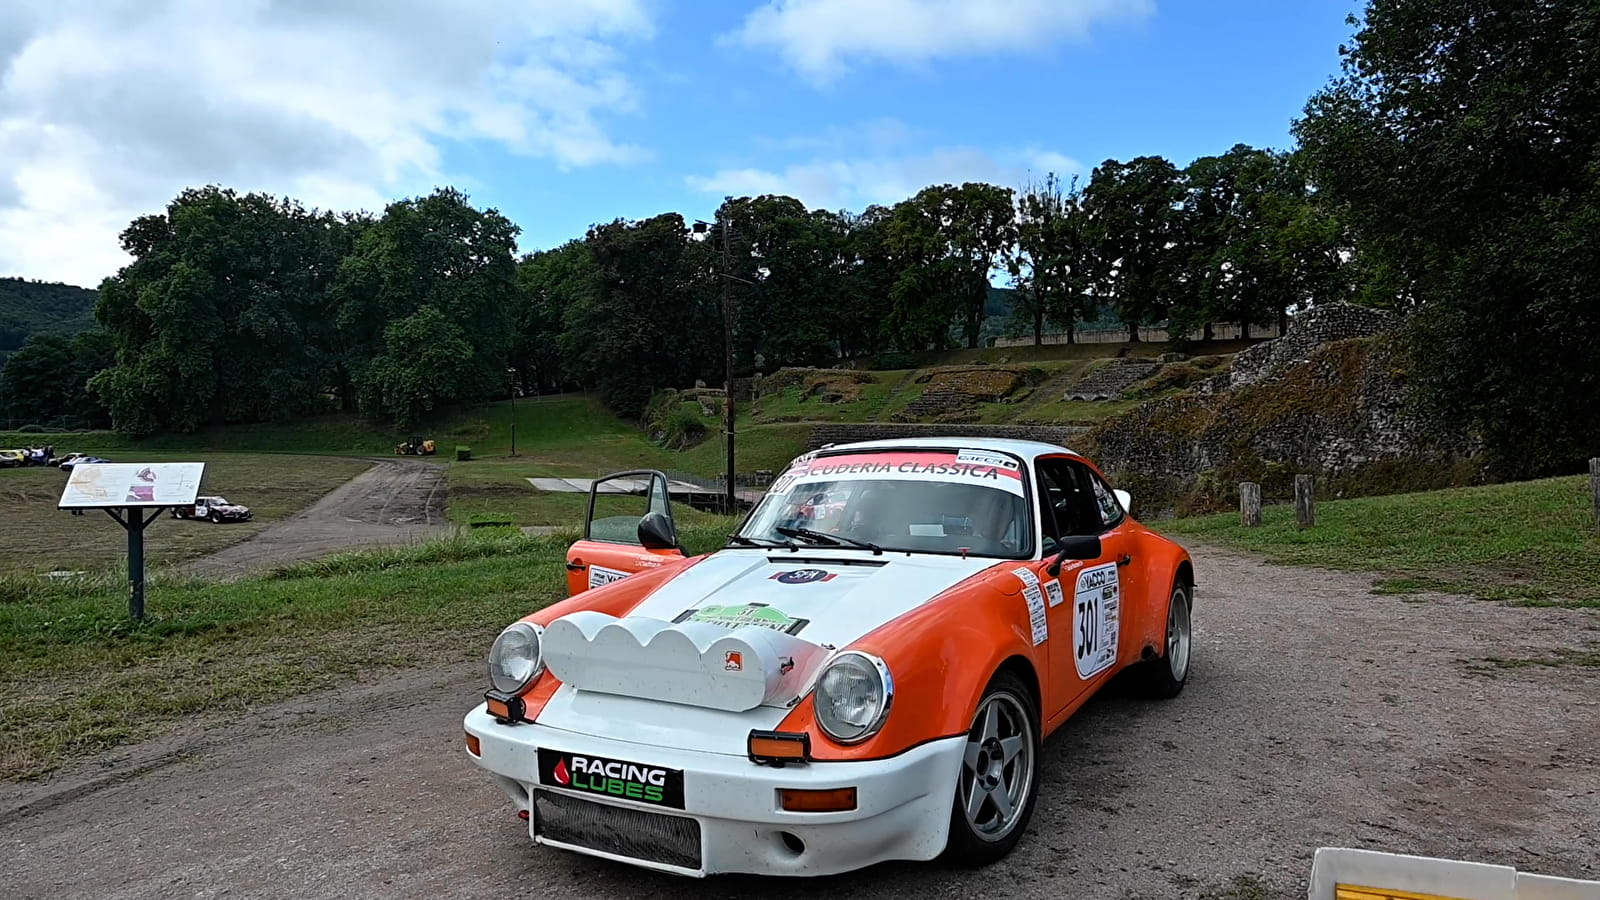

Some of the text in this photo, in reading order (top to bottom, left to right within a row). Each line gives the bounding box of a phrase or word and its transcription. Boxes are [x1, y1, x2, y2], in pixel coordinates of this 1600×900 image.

[799, 462, 998, 480] SCUDERIA CLASSICA
[1078, 597, 1098, 660] 301
[571, 756, 666, 786] RACING
[572, 773, 663, 801] LUBES
